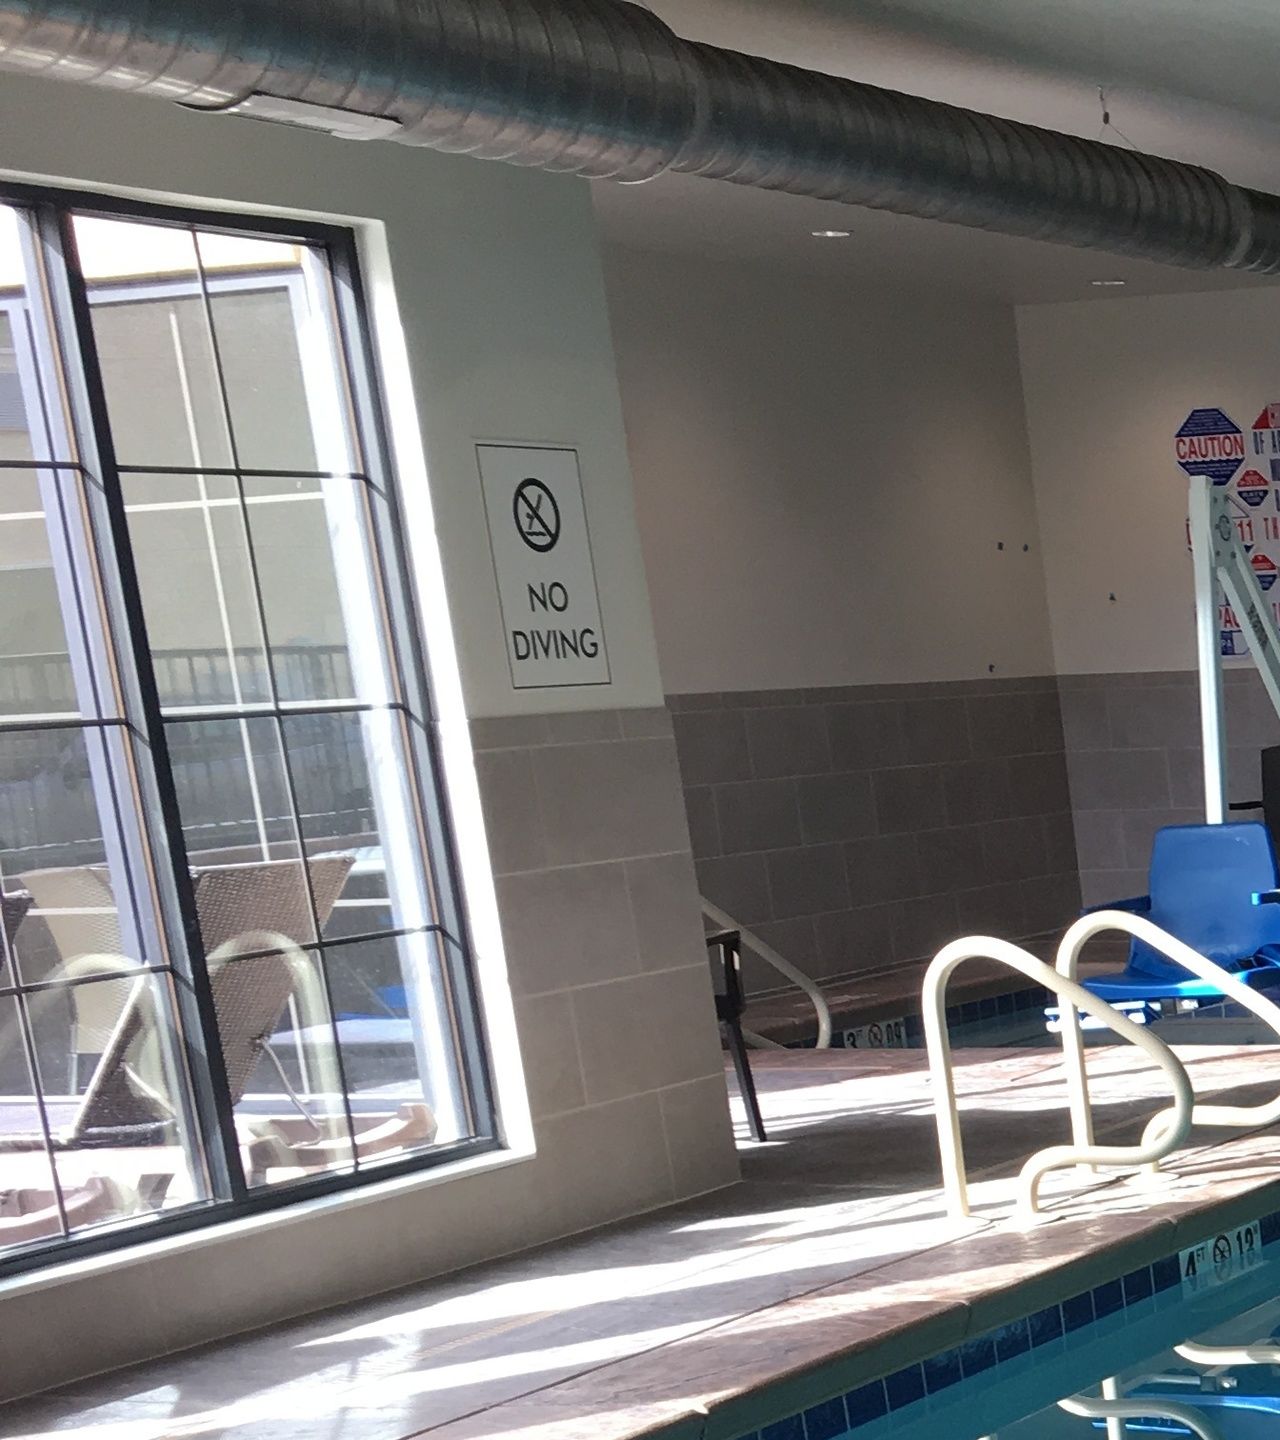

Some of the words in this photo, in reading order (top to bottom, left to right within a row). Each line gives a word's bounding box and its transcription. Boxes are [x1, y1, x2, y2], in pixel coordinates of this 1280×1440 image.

[1176, 435, 1244, 460] CAUTION
[1237, 519, 1254, 541] 11
[527, 581, 569, 613] NO
[512, 628, 599, 661] DIVING
